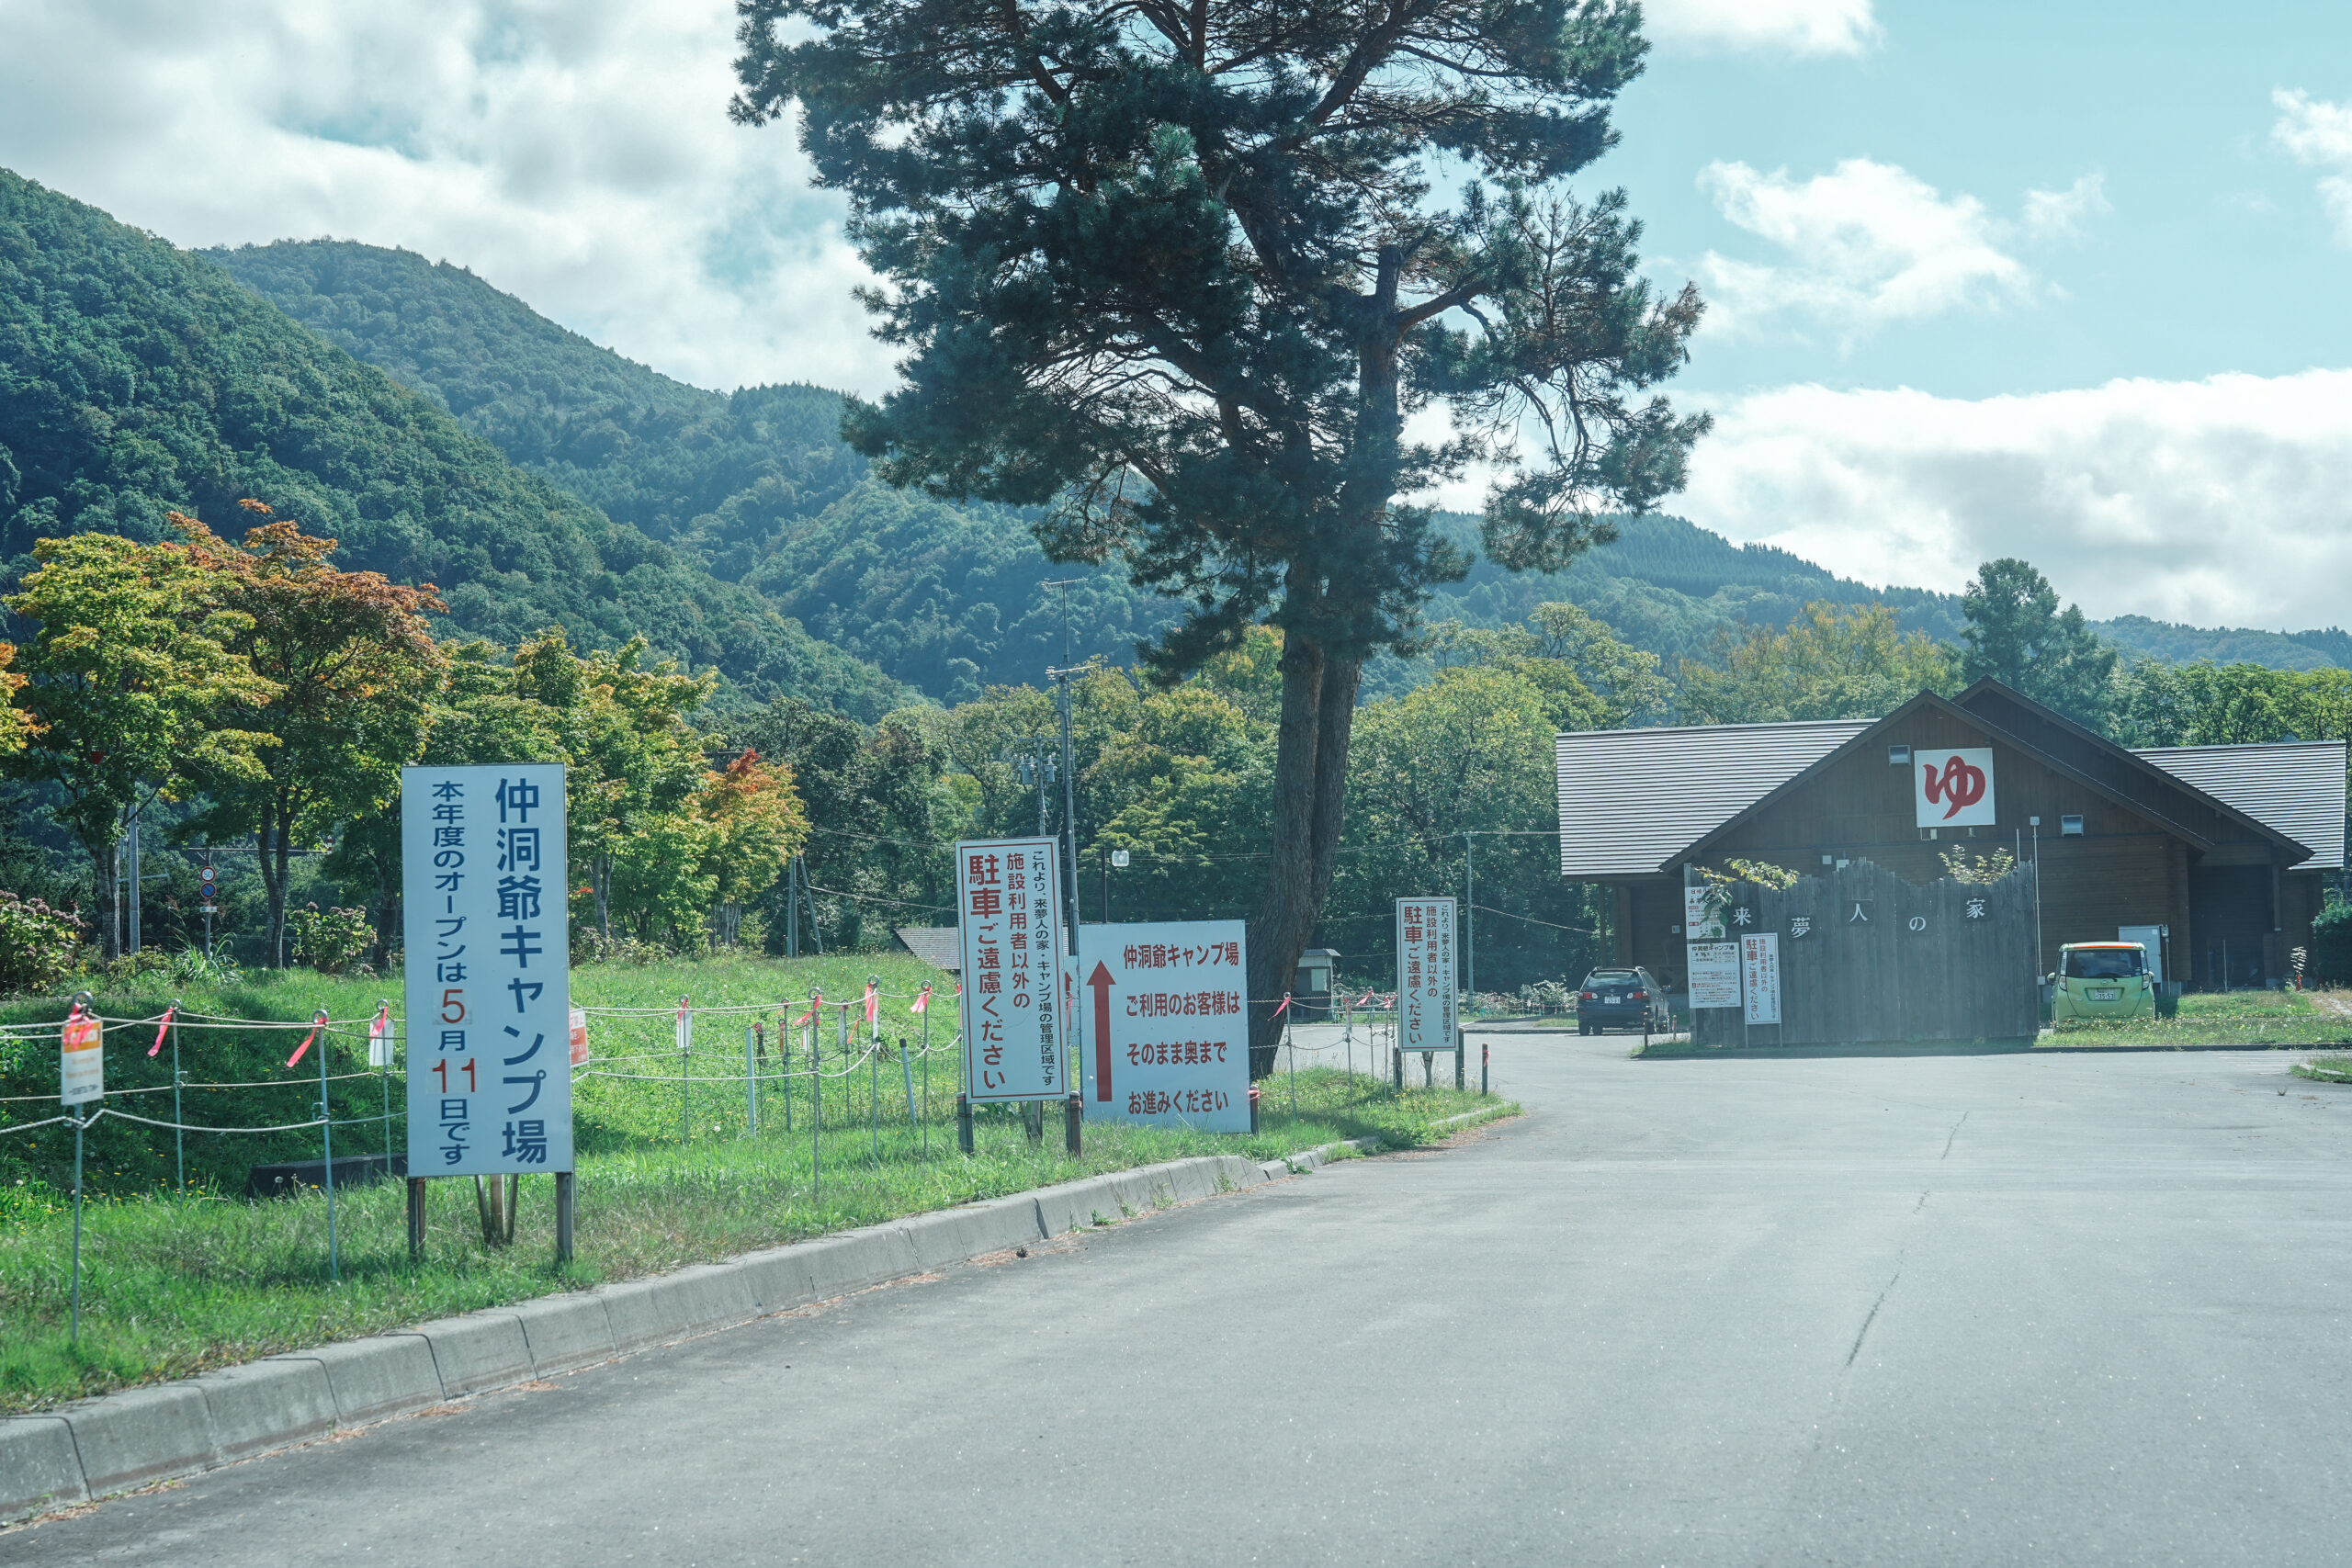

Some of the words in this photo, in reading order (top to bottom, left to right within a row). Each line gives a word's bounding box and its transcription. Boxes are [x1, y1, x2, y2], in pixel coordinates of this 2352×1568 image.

[1924, 755, 1986, 820] ゆ
[431, 781, 477, 1166] 本年度のオープンは5月11日です
[495, 778, 548, 1165] 仲洞爺キャンプ場
[968, 854, 1006, 1089] 駐車ご遠慮ください
[1007, 852, 1031, 1009] 施設利用者以外の
[1124, 942, 1239, 969] 仲洞爺キャンプ場
[1404, 906, 1423, 1044] 駐車ご遠慮ください
[1426, 906, 1438, 998] 施設利用者以外の
[1126, 991, 1240, 1018] ご利用のお客様は
[1126, 1040, 1227, 1066] そのまま奥まで
[1128, 1089, 1228, 1115] お進みください
